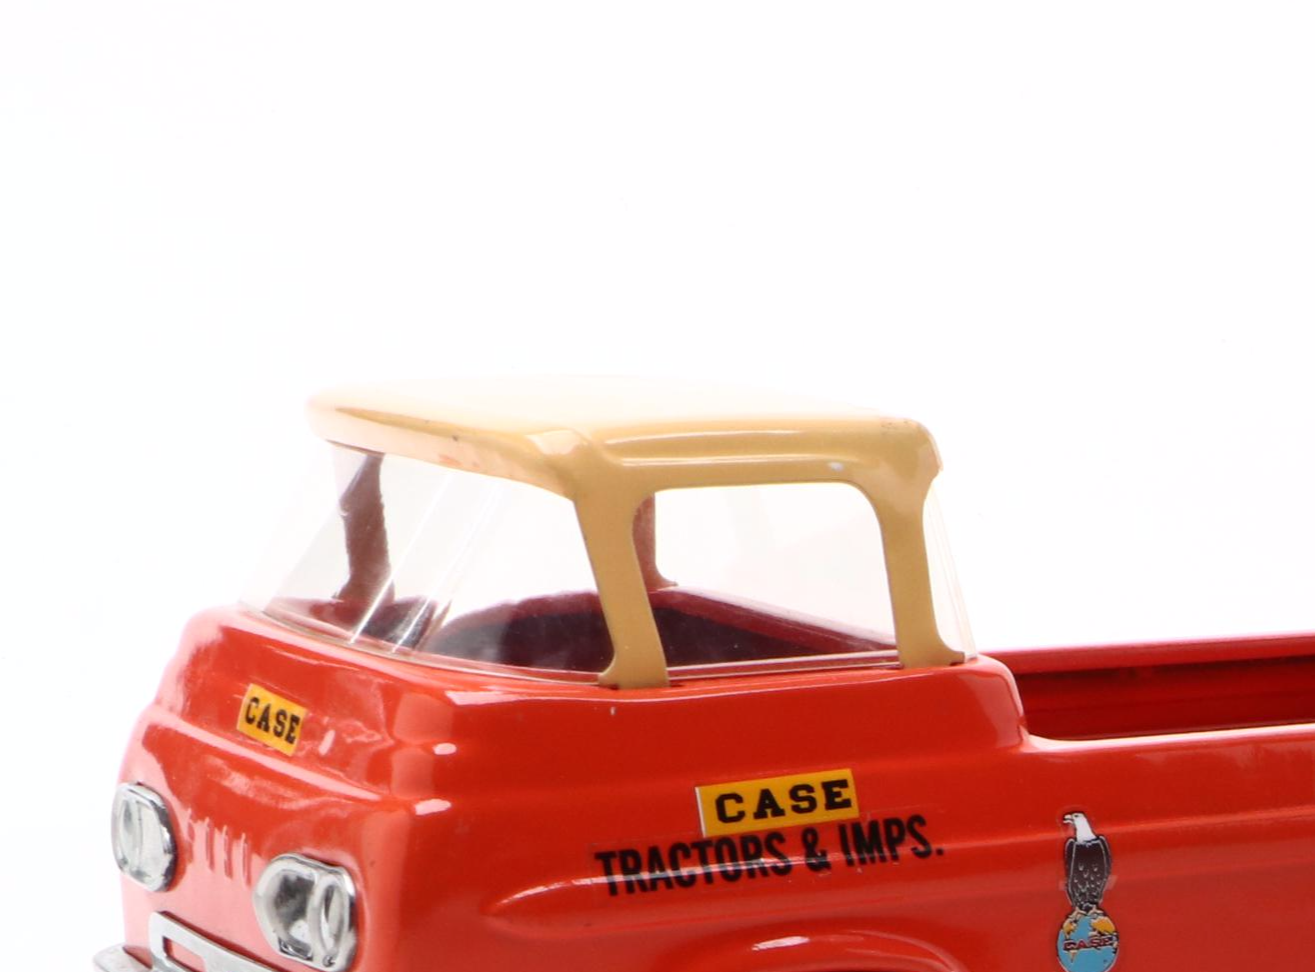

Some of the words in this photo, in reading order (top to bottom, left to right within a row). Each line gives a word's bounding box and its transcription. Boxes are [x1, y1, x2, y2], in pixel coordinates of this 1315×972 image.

[245, 696, 301, 745] CASE
[715, 779, 853, 824] CASE
[595, 832, 799, 896] TRACTORS
[804, 827, 832, 871] &
[840, 814, 944, 867] IMPS.
[1063, 936, 1114, 951] CASE
